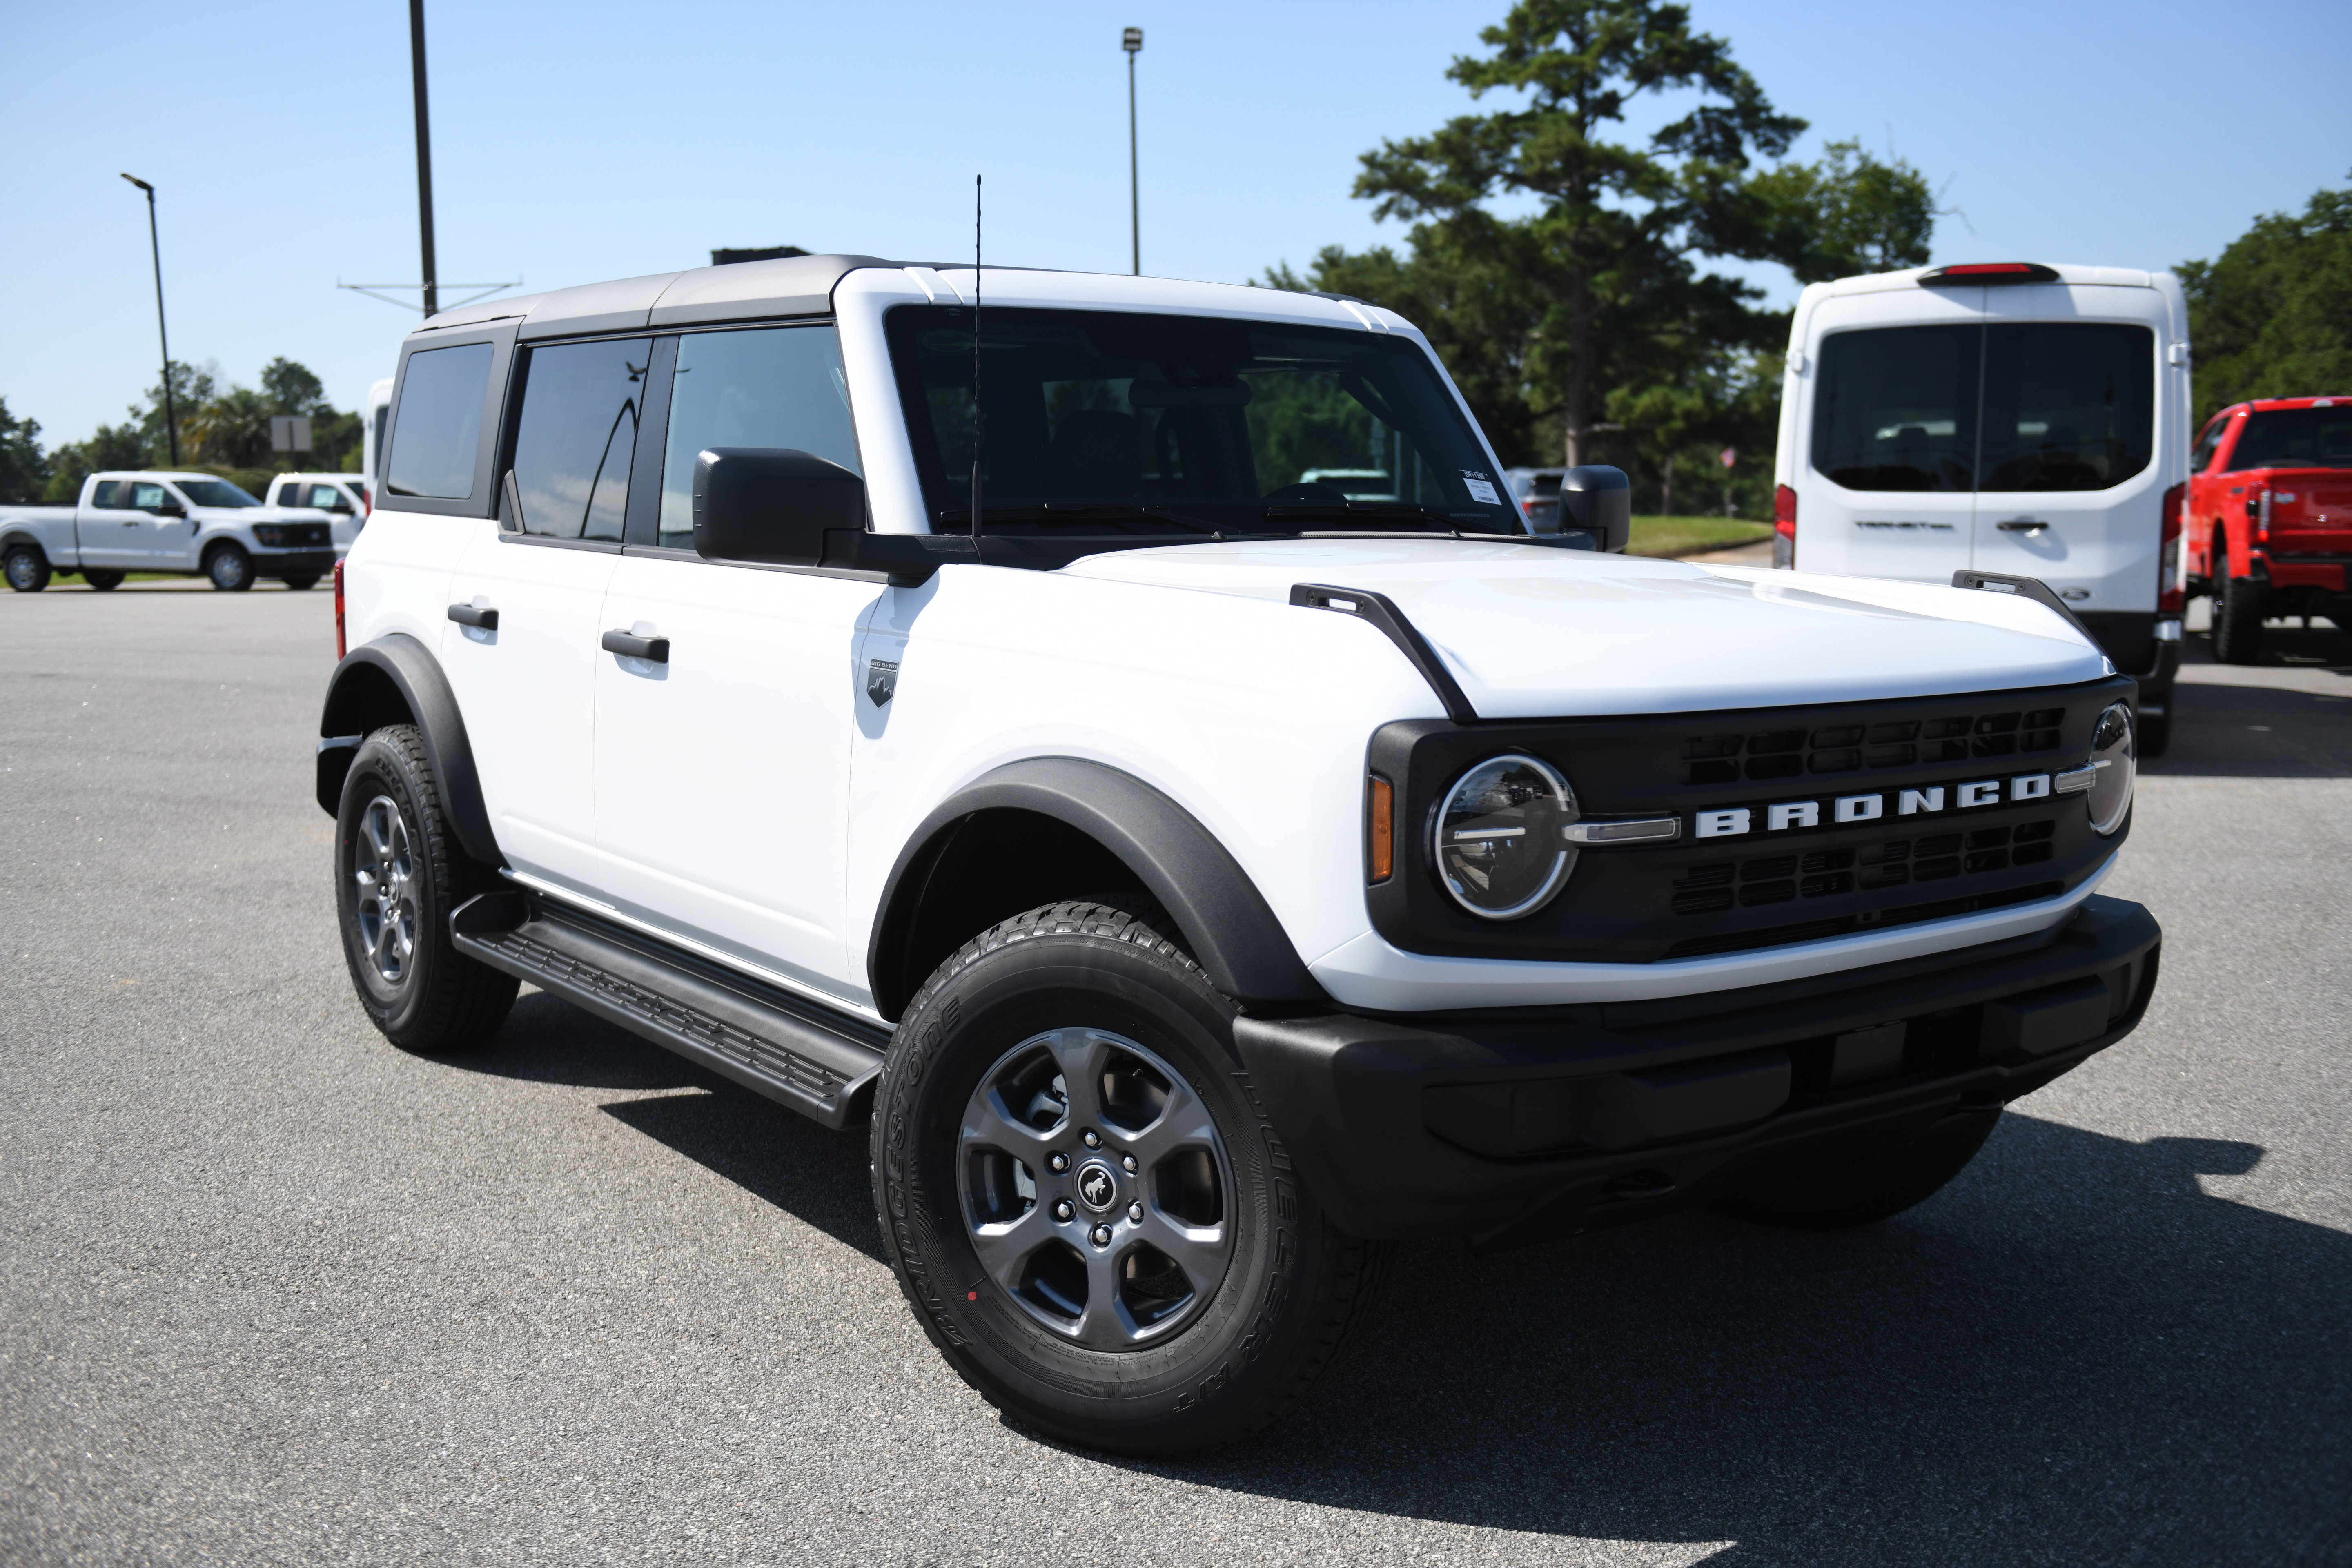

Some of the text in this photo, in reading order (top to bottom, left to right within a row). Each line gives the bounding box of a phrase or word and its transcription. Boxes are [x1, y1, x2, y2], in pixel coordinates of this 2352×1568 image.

[1463, 471, 1486, 480] BR11398
[1695, 773, 2050, 838] BRONCO
[886, 994, 973, 1347] BRIDGESTONE
